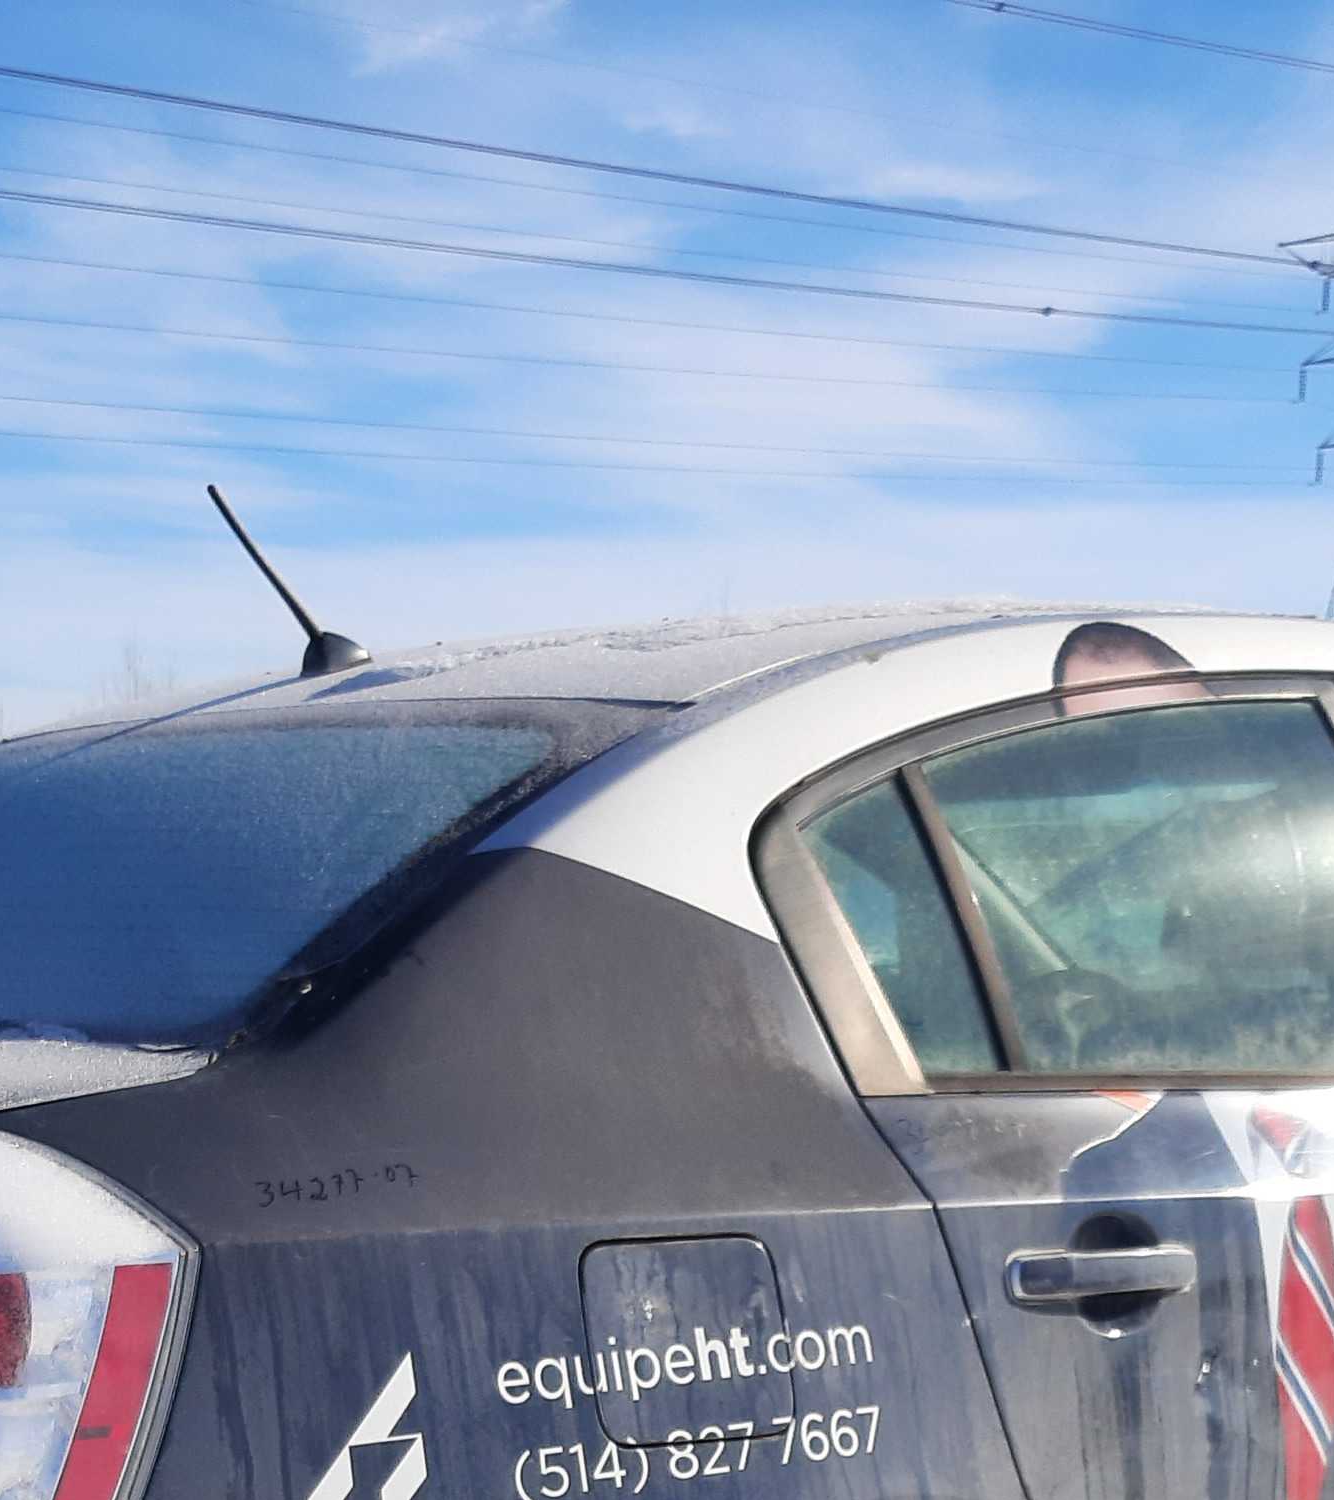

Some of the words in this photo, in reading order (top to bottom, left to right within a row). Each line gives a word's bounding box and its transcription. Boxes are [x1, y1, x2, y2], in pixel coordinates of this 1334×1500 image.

[496, 1323, 874, 1409] equipeht.com
[668, 1422, 755, 1481] 827
[779, 1406, 881, 1466] 7667
